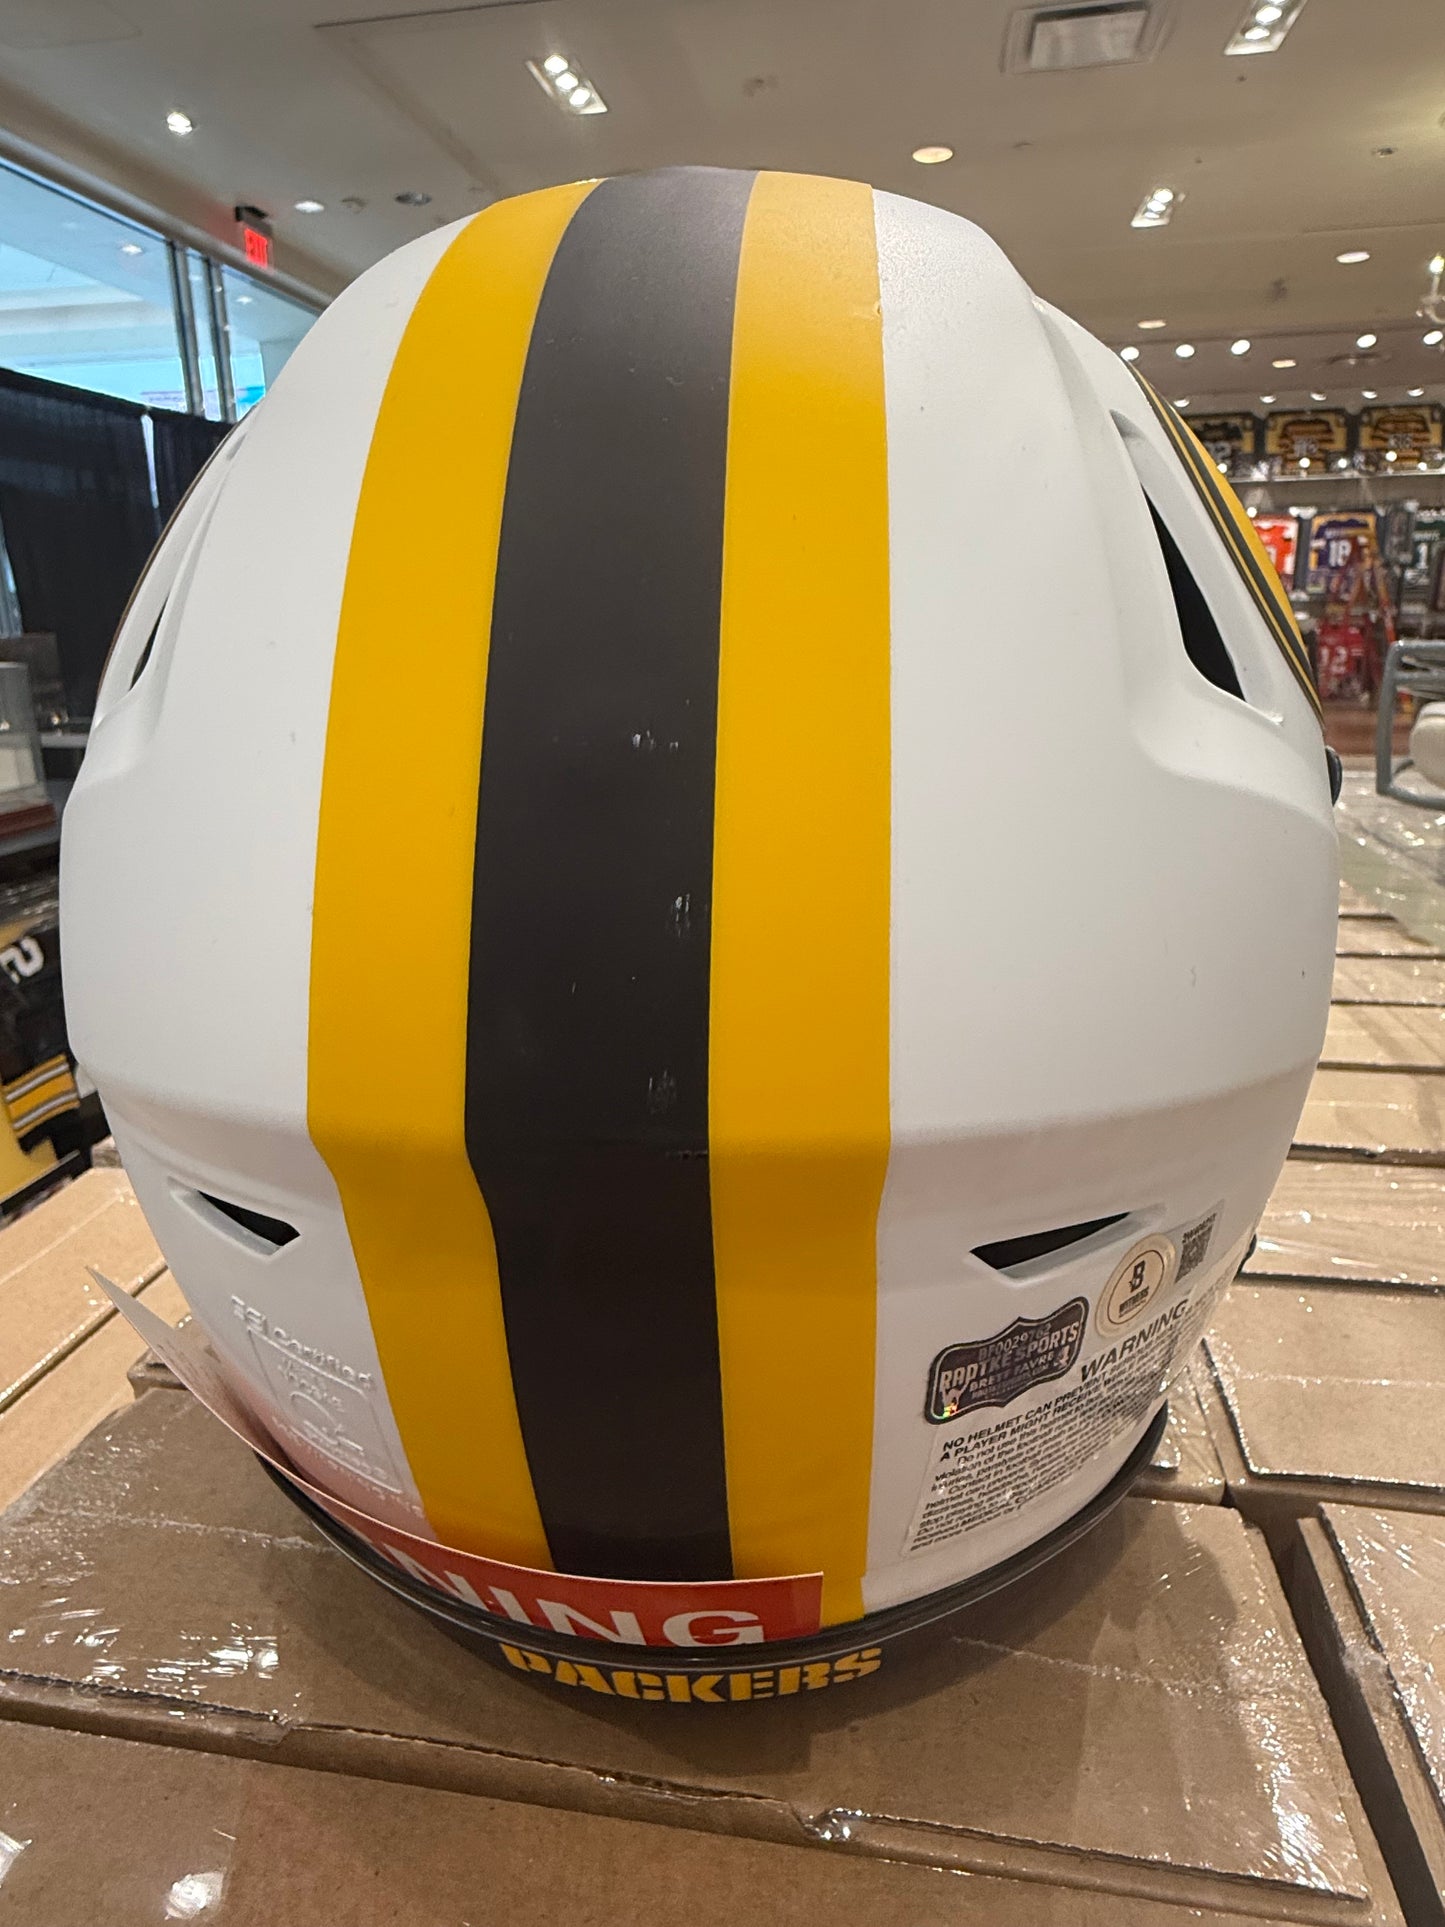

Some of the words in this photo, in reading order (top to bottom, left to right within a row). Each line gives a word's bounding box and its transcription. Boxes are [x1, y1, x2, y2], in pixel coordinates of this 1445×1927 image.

[1014, 1352, 1053, 1376] FAVRE
[1015, 1322, 1079, 1362] SPORTS
[1083, 1299, 1188, 1381] WARNING
[940, 1452, 951, 1462] A
[955, 1432, 1007, 1456] PLAYER
[1010, 1412, 1050, 1435] MIGHT
[943, 1437, 965, 1452] NO
[968, 1415, 1022, 1443] HELMET
[1024, 1401, 1052, 1421] CAN
[977, 1446, 995, 1459] not
[340, 1520, 765, 1647] NING
[501, 1643, 882, 1702] PACKERS
